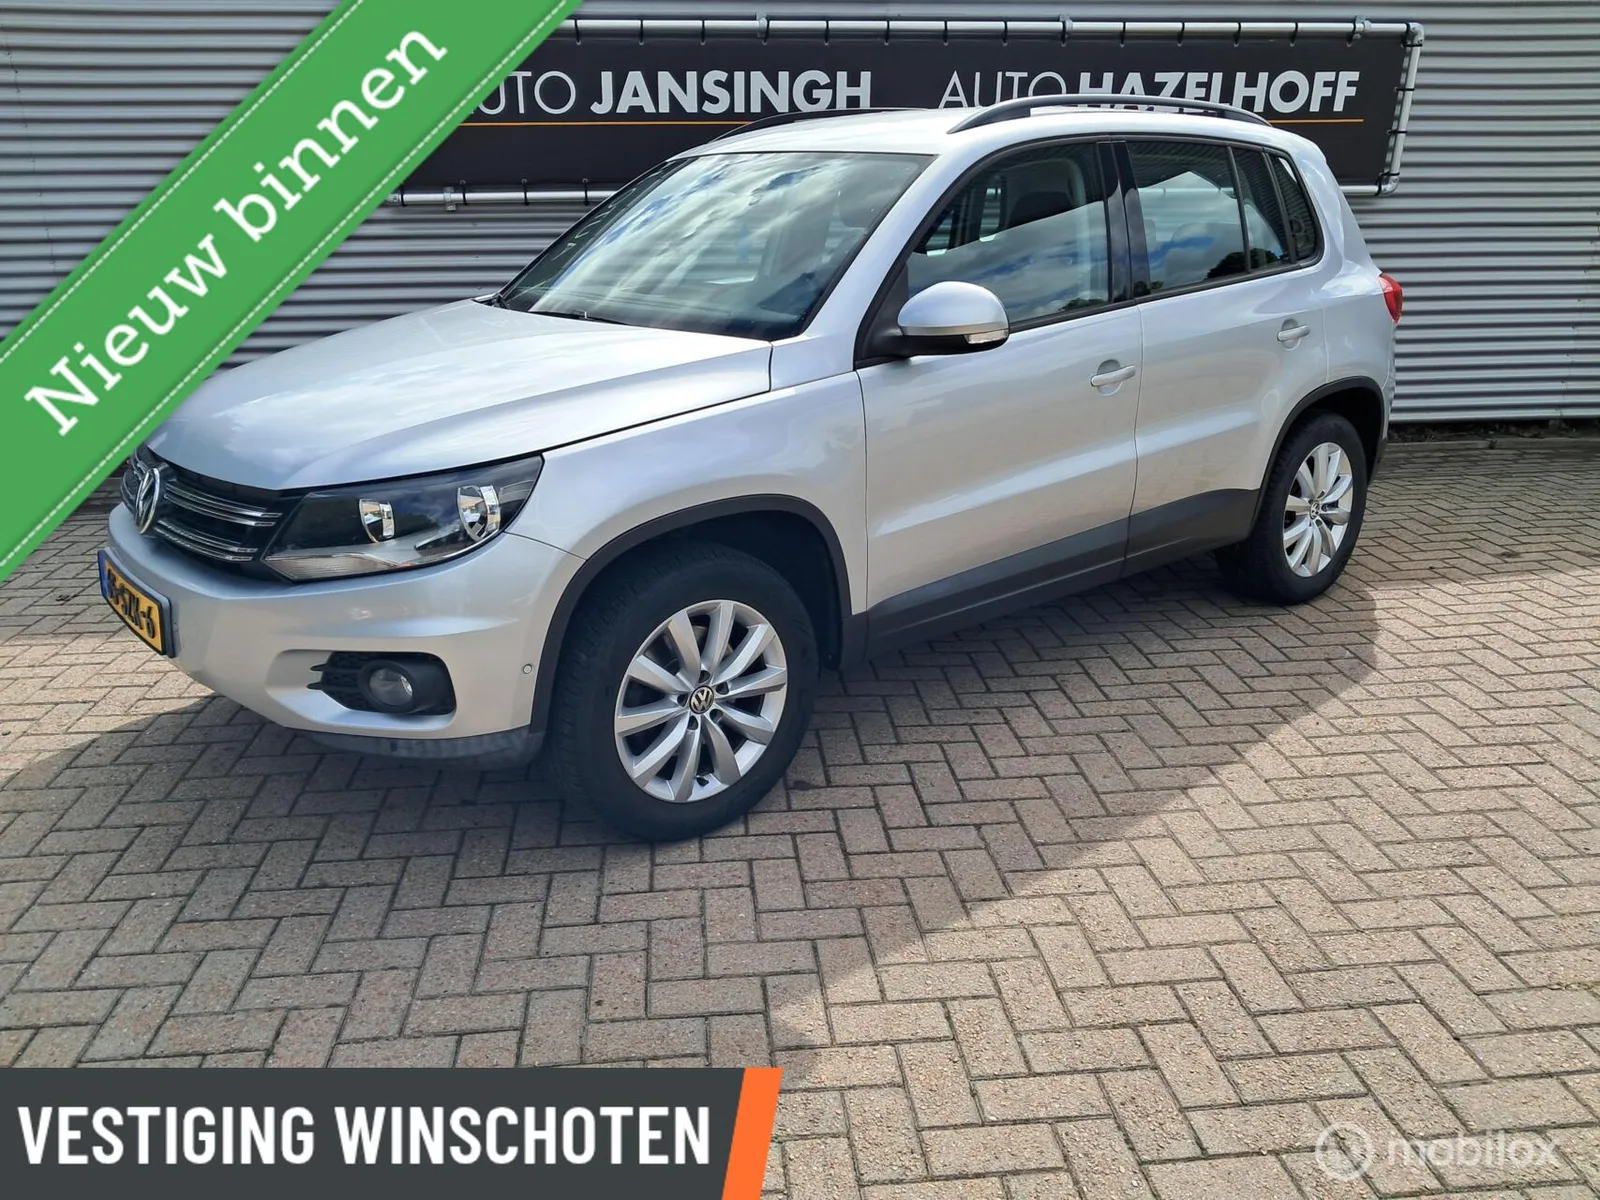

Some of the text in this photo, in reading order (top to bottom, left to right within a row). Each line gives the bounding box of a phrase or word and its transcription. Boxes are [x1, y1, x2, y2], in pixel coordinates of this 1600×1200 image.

[471, 71, 871, 115] UTO JANSINGH
[938, 70, 1360, 113] AUTO HAZELHOFF
